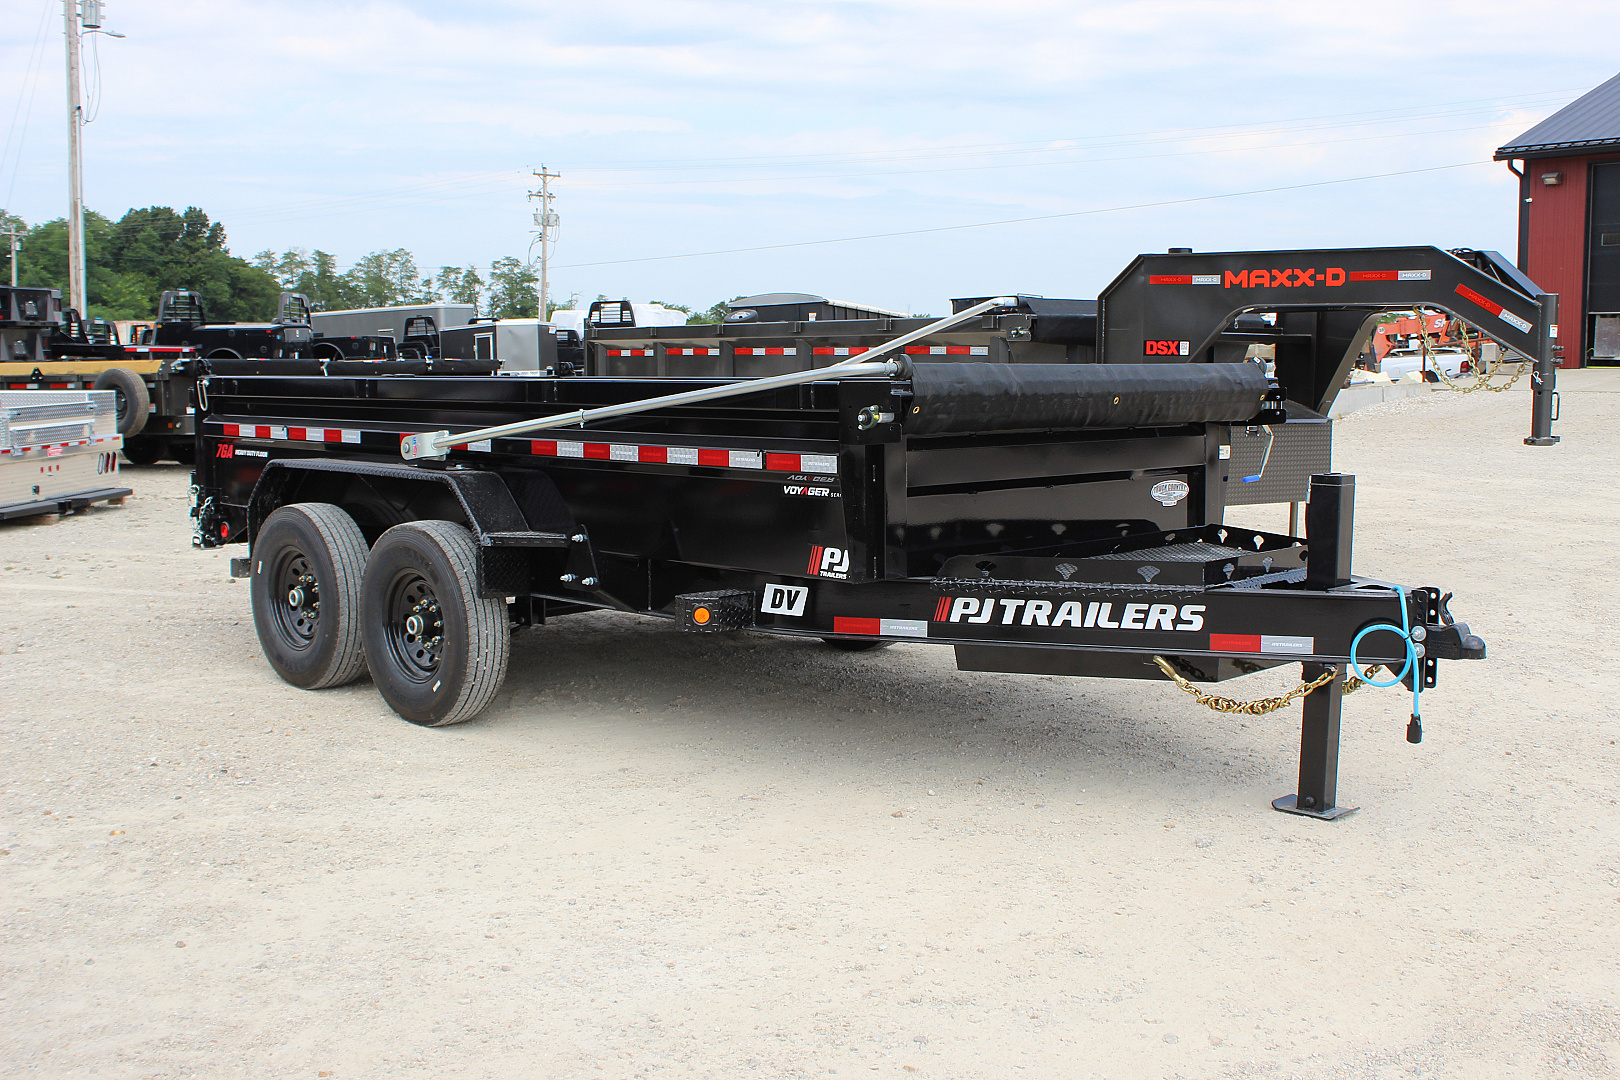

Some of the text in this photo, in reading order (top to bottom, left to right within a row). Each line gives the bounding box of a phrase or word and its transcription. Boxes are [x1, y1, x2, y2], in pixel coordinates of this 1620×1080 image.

[1224, 267, 1346, 289] MAXX-D
[1503, 313, 1527, 330] MAXX-D
[1145, 340, 1179, 355] DSX
[216, 443, 234, 459] 7GA
[783, 485, 830, 497] VOYAGER
[820, 547, 850, 573] PJ
[820, 571, 847, 579] TRAILERS
[770, 588, 801, 611] DV
[949, 597, 1207, 631] PJ TRAILERS
